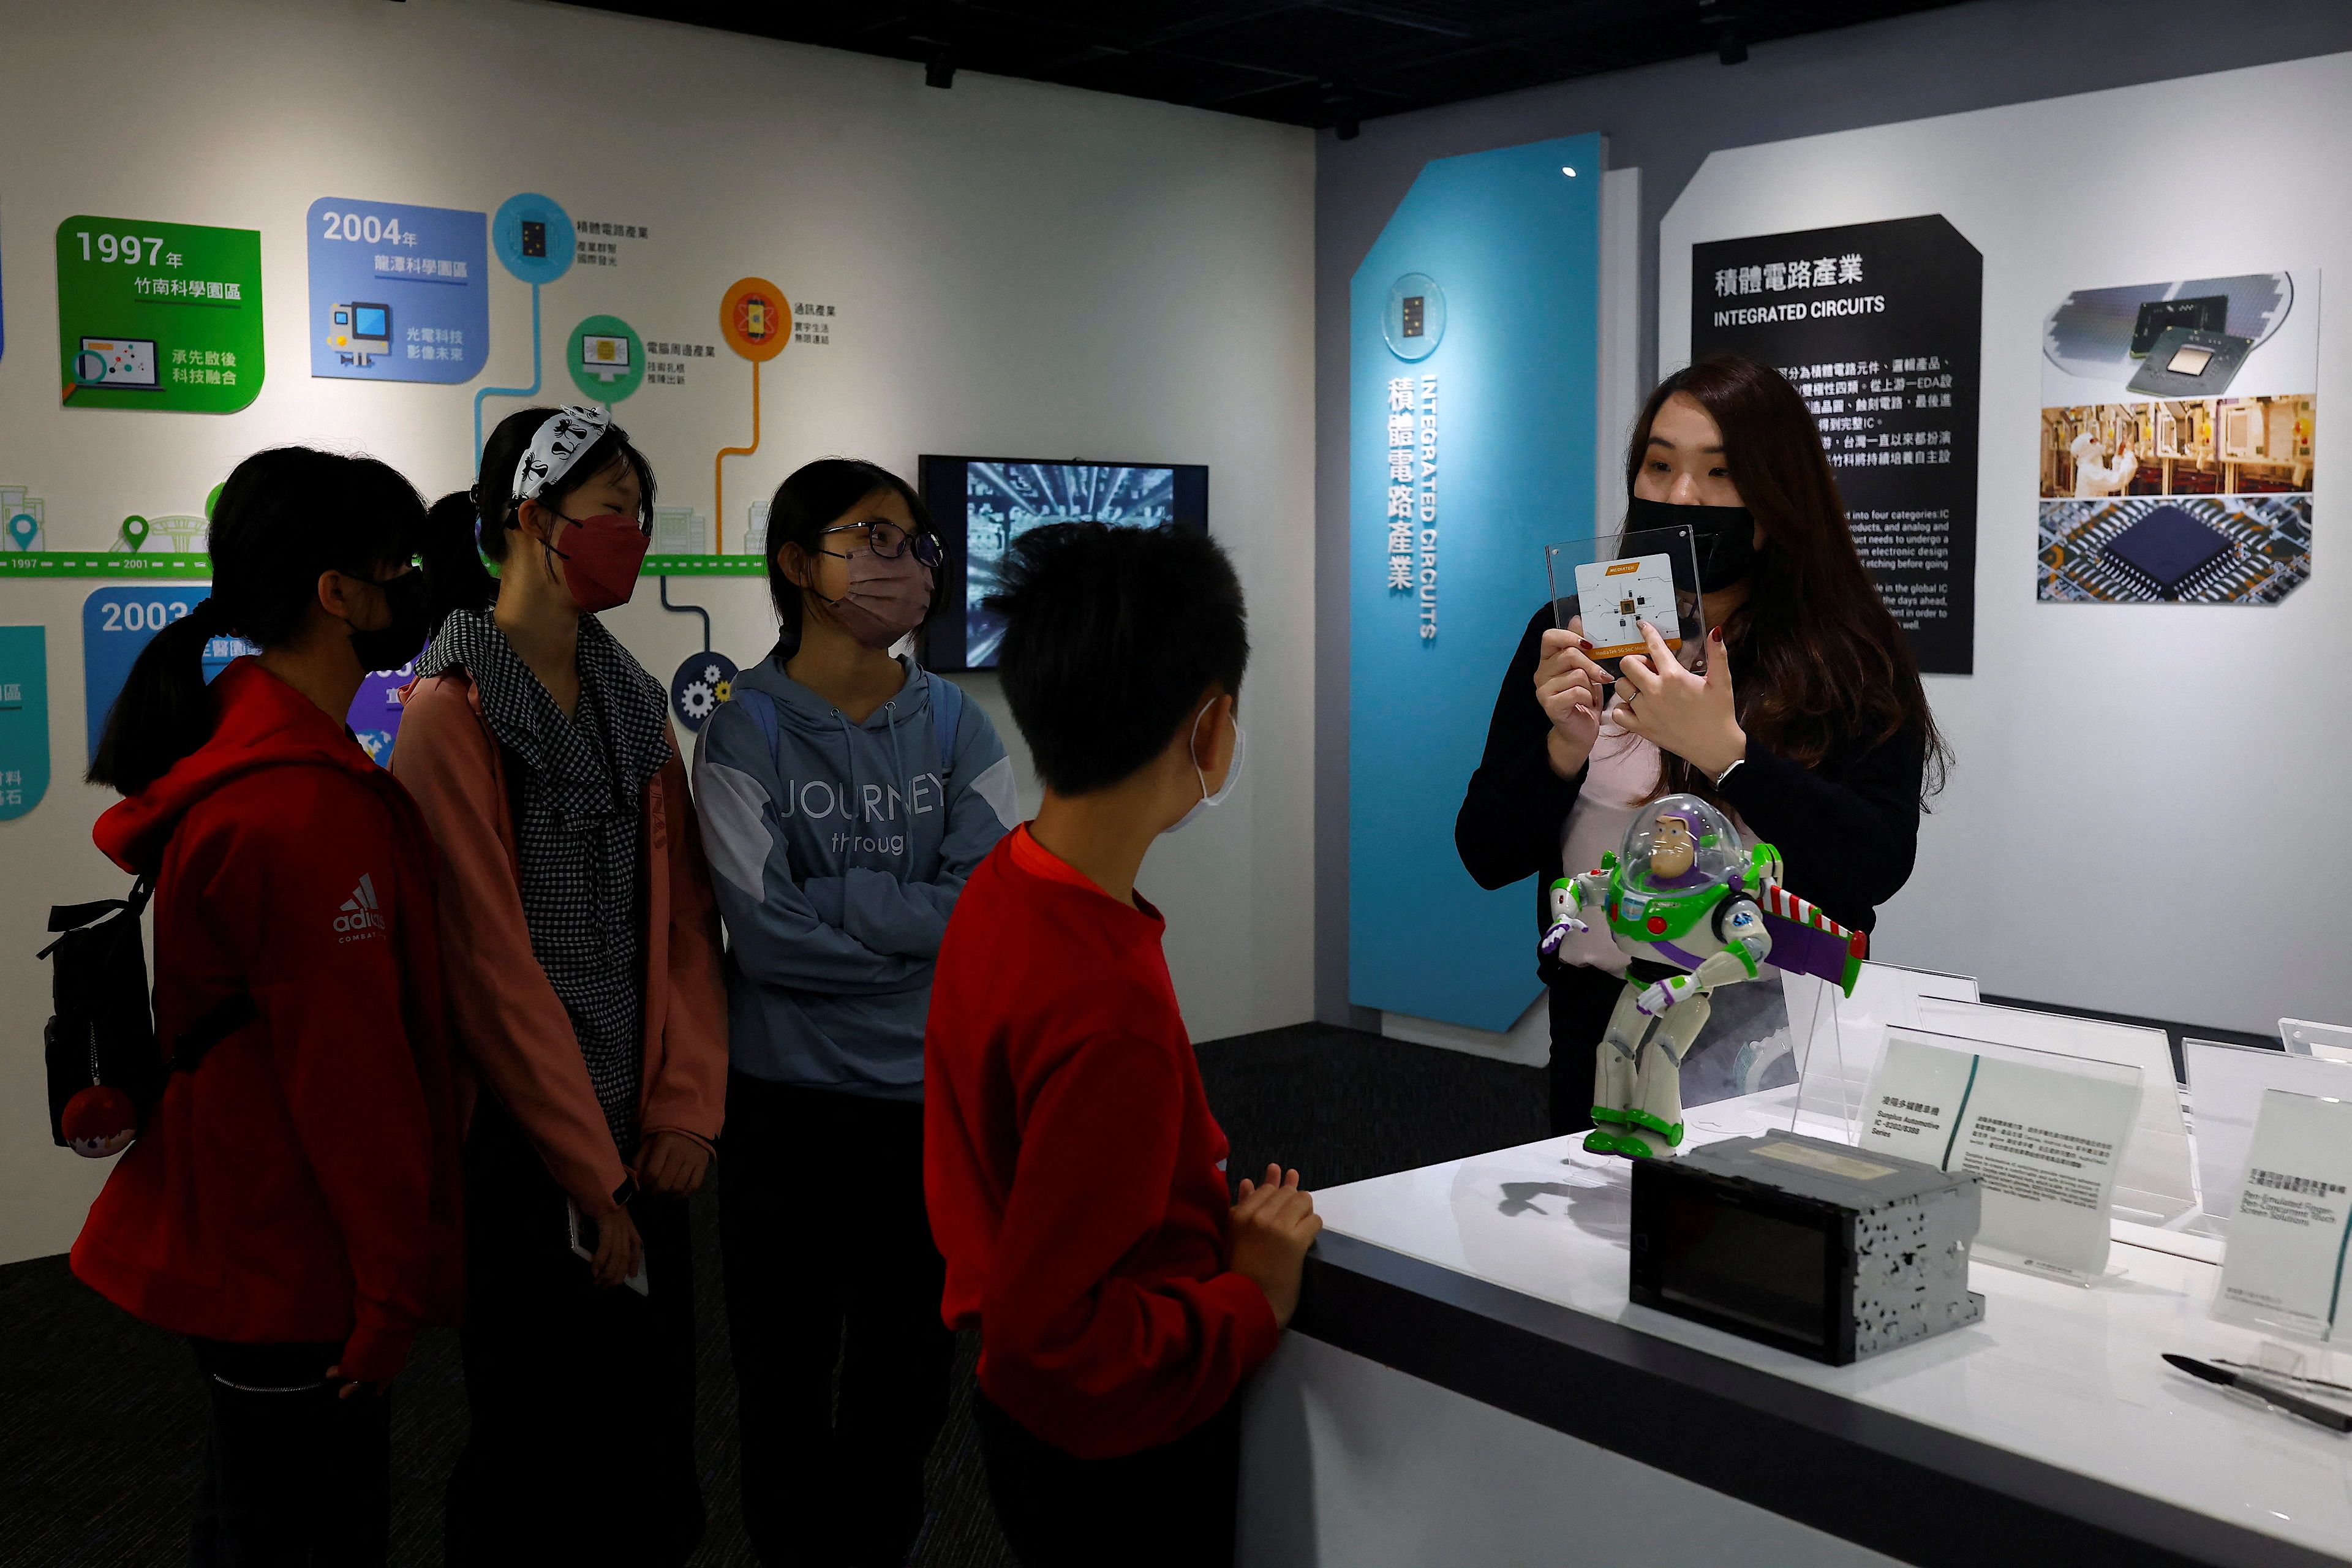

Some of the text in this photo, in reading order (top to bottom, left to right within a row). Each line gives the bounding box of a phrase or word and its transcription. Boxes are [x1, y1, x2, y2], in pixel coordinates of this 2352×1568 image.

[578, 221, 648, 239] 積體電路產業
[374, 255, 467, 277] 龍潭科學園區
[1715, 253, 1863, 298] 積體電路產業
[135, 277, 241, 300] 竹南科學園區
[1714, 295, 1885, 326] INTEGRATED CIRCUITS
[407, 328, 463, 344] 光電科技
[172, 349, 237, 367] 承先啟後
[407, 344, 463, 361] 影像未來
[172, 368, 237, 385] 科技融合
[1387, 377, 1415, 590] 積體電路產業
[1420, 375, 1438, 640] INTEGRATED CIRCUITS
[1852, 511, 1869, 520] into
[1871, 510, 1888, 520] four
[1891, 510, 1937, 521] categories
[1940, 509, 1950, 518] IC
[1884, 522, 1900, 531] and
[1902, 522, 1931, 533] analog
[1933, 521, 1950, 531] and
[1869, 534, 1894, 544] needs
[1896, 535, 1904, 544] to
[1906, 534, 1941, 546] undergo
[1871, 546, 1915, 556] electronic
[1918, 546, 1948, 558] design
[12, 559, 37, 568] 1997
[124, 559, 148, 568] 2001
[1898, 559, 1923, 568] before
[1924, 559, 1949, 570] going
[1885, 583, 1893, 592] in
[1895, 583, 1909, 593] the
[1910, 583, 1937, 594] global
[1939, 583, 1948, 593] IC
[1898, 595, 1917, 607] days
[1905, 608, 1914, 617] in
[1915, 608, 1936, 618] order
[1939, 609, 1947, 618] to
[781, 772, 944, 823] JOURNEY
[338, 932, 376, 944] COMBAT
[1904, 1117, 1940, 1130] Automotive
[1872, 1128, 1891, 1137] Series
